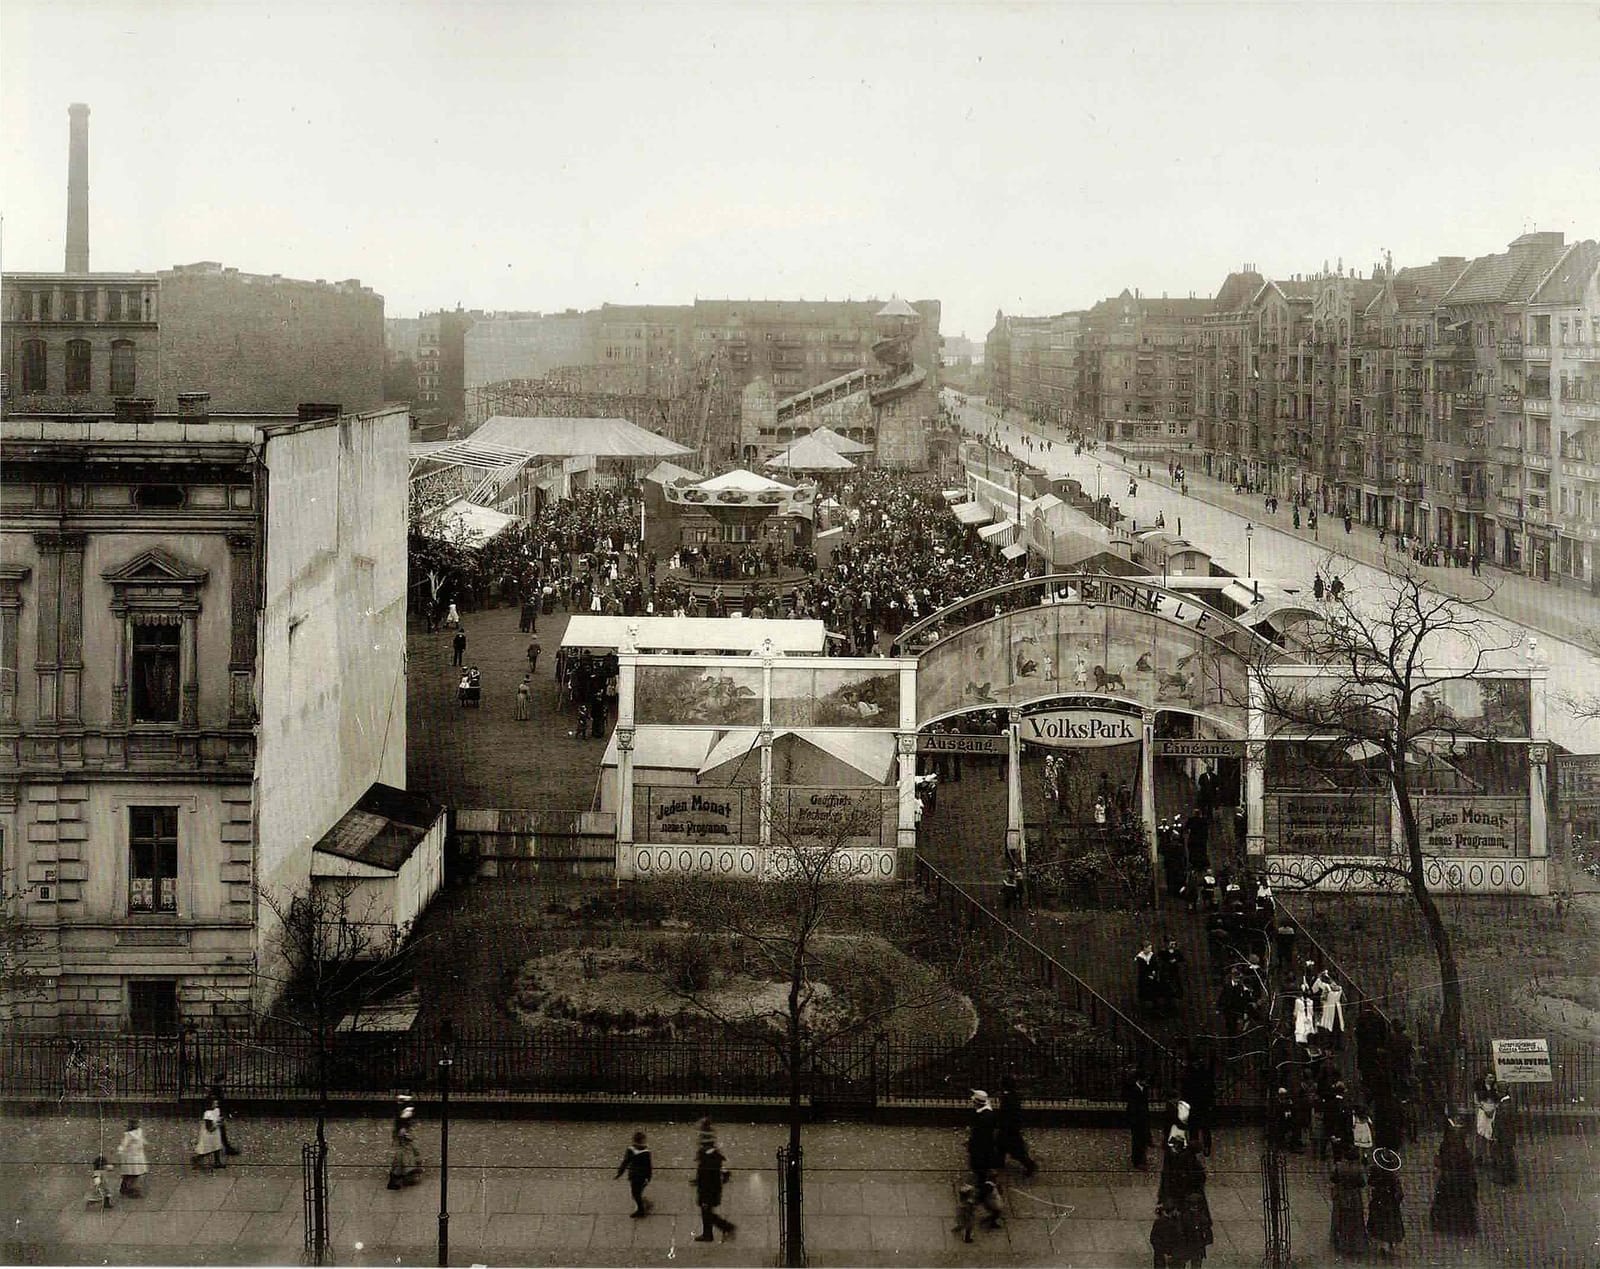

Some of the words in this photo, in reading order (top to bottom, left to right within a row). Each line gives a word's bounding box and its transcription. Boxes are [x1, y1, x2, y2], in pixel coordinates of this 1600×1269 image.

[656, 799, 688, 820] Jeden
[691, 794, 732, 818] Monat
[1425, 812, 1458, 832] Jeden
[1461, 807, 1508, 829] Monat
